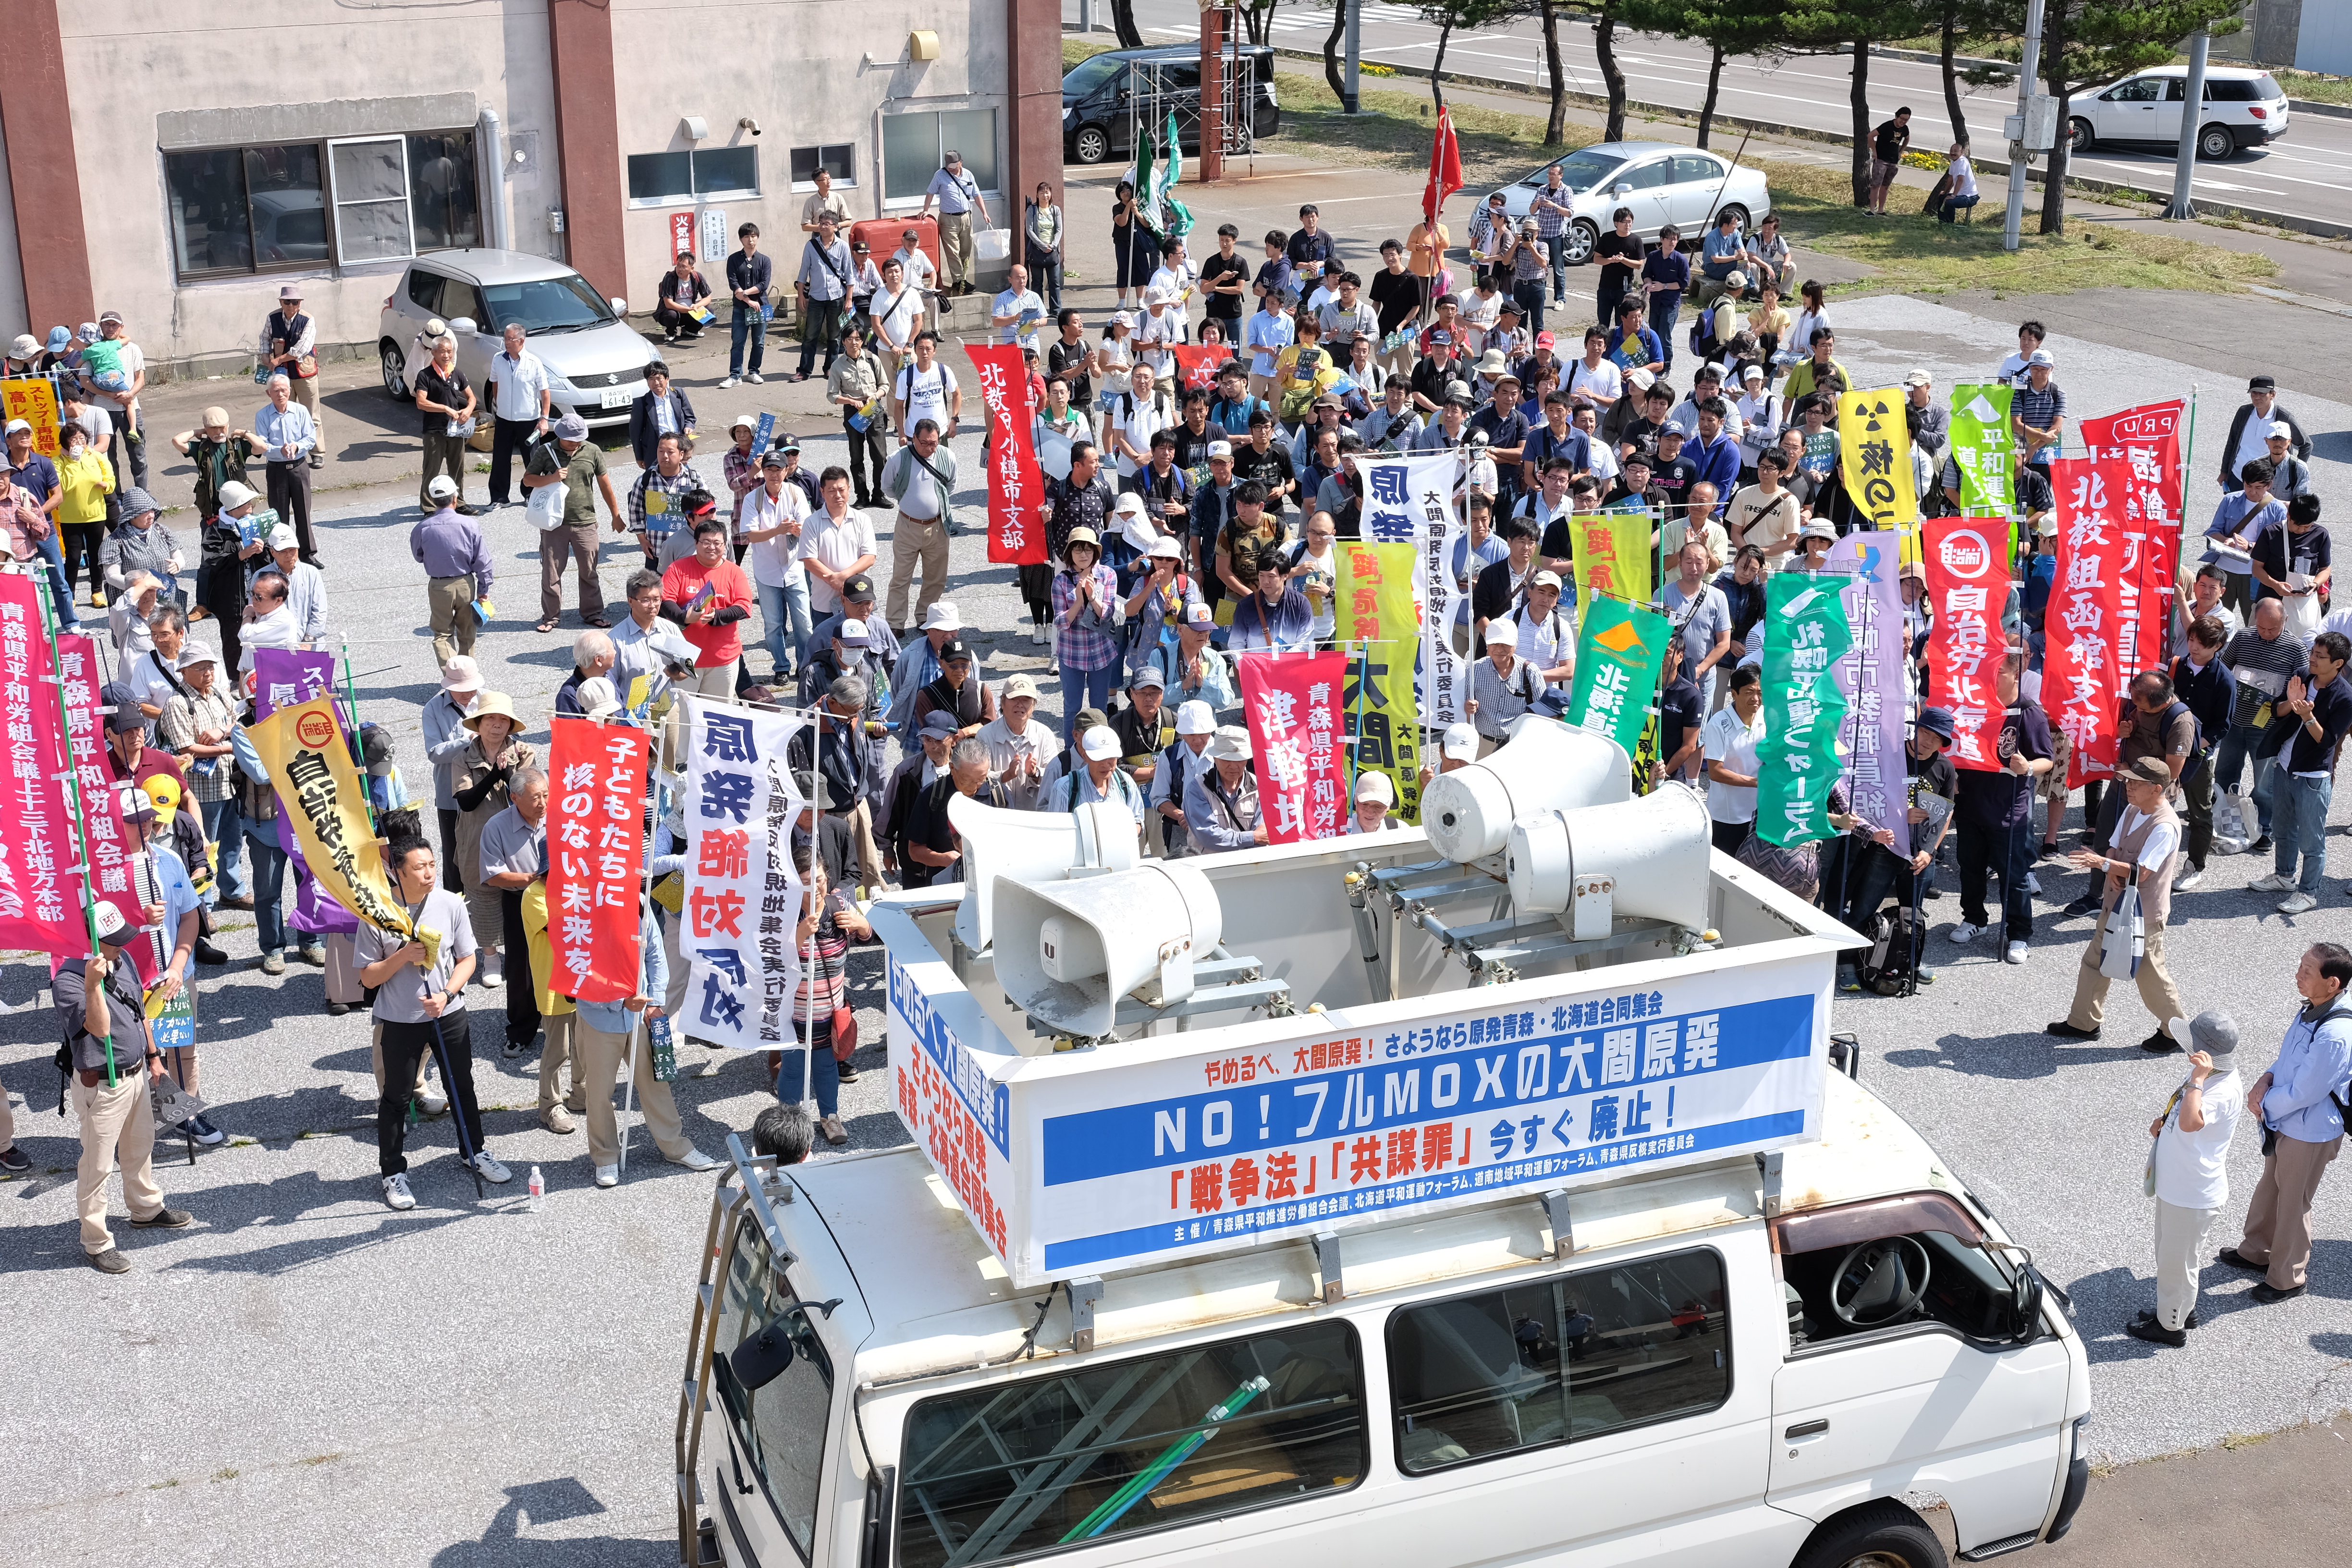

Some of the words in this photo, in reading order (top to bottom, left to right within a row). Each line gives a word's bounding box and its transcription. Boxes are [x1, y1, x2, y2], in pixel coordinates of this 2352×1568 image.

[10, 391, 30, 422] 高レ
[609, 395, 631, 406] 61-43
[955, 640, 962, 651] B
[1945, 584, 1989, 762] 自治労北海道
[2059, 471, 2110, 749] 北教組函館支部
[0, 602, 65, 922] 青森県平和労組会議上十三下北地方本部
[268, 682, 299, 710] 原
[1257, 688, 1308, 841] 津軽地
[60, 651, 129, 893] 青森県平和労組会議
[596, 737, 638, 907] 子どもたちに
[1919, 799, 1947, 818] STOP
[561, 762, 596, 995] 核のない未来を!
[160, 1029, 190, 1044] 必要ない
[891, 958, 1004, 1141] やめるべ、大間原発!
[1154, 1013, 1720, 1157] NO!フルMOXの大間原発
[1385, 990, 1664, 1059] さようなら原発青森・北海道合同集会
[166, 1099, 198, 1122] STOP
[897, 1062, 1007, 1262] 青森・北海道合同集会
[911, 1041, 987, 1184] さようなら原発
[1170, 1121, 1471, 1214] 「戦争法」「共謀罪」
[1490, 1109, 1574, 1160] 今すぐ
[1588, 1086, 1677, 1144] 廃止!
